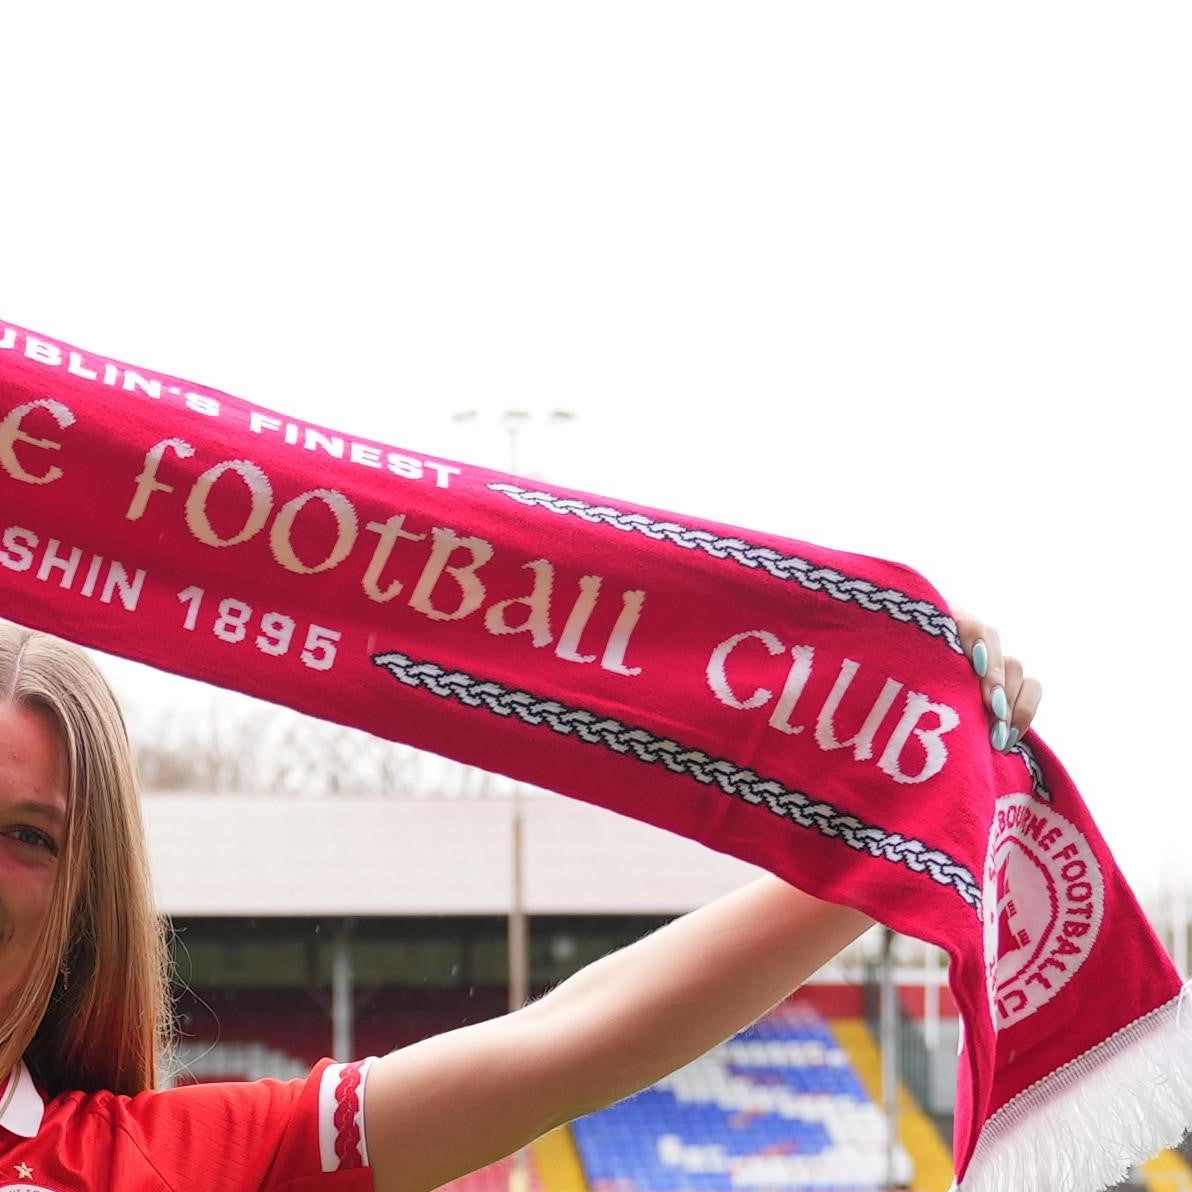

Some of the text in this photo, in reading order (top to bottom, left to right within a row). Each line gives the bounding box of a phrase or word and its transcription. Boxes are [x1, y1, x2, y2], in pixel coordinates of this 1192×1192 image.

[249, 411, 461, 488] FINEST
[177, 586, 341, 671] 1895
[1025, 843, 1094, 989] FOOTBALL
